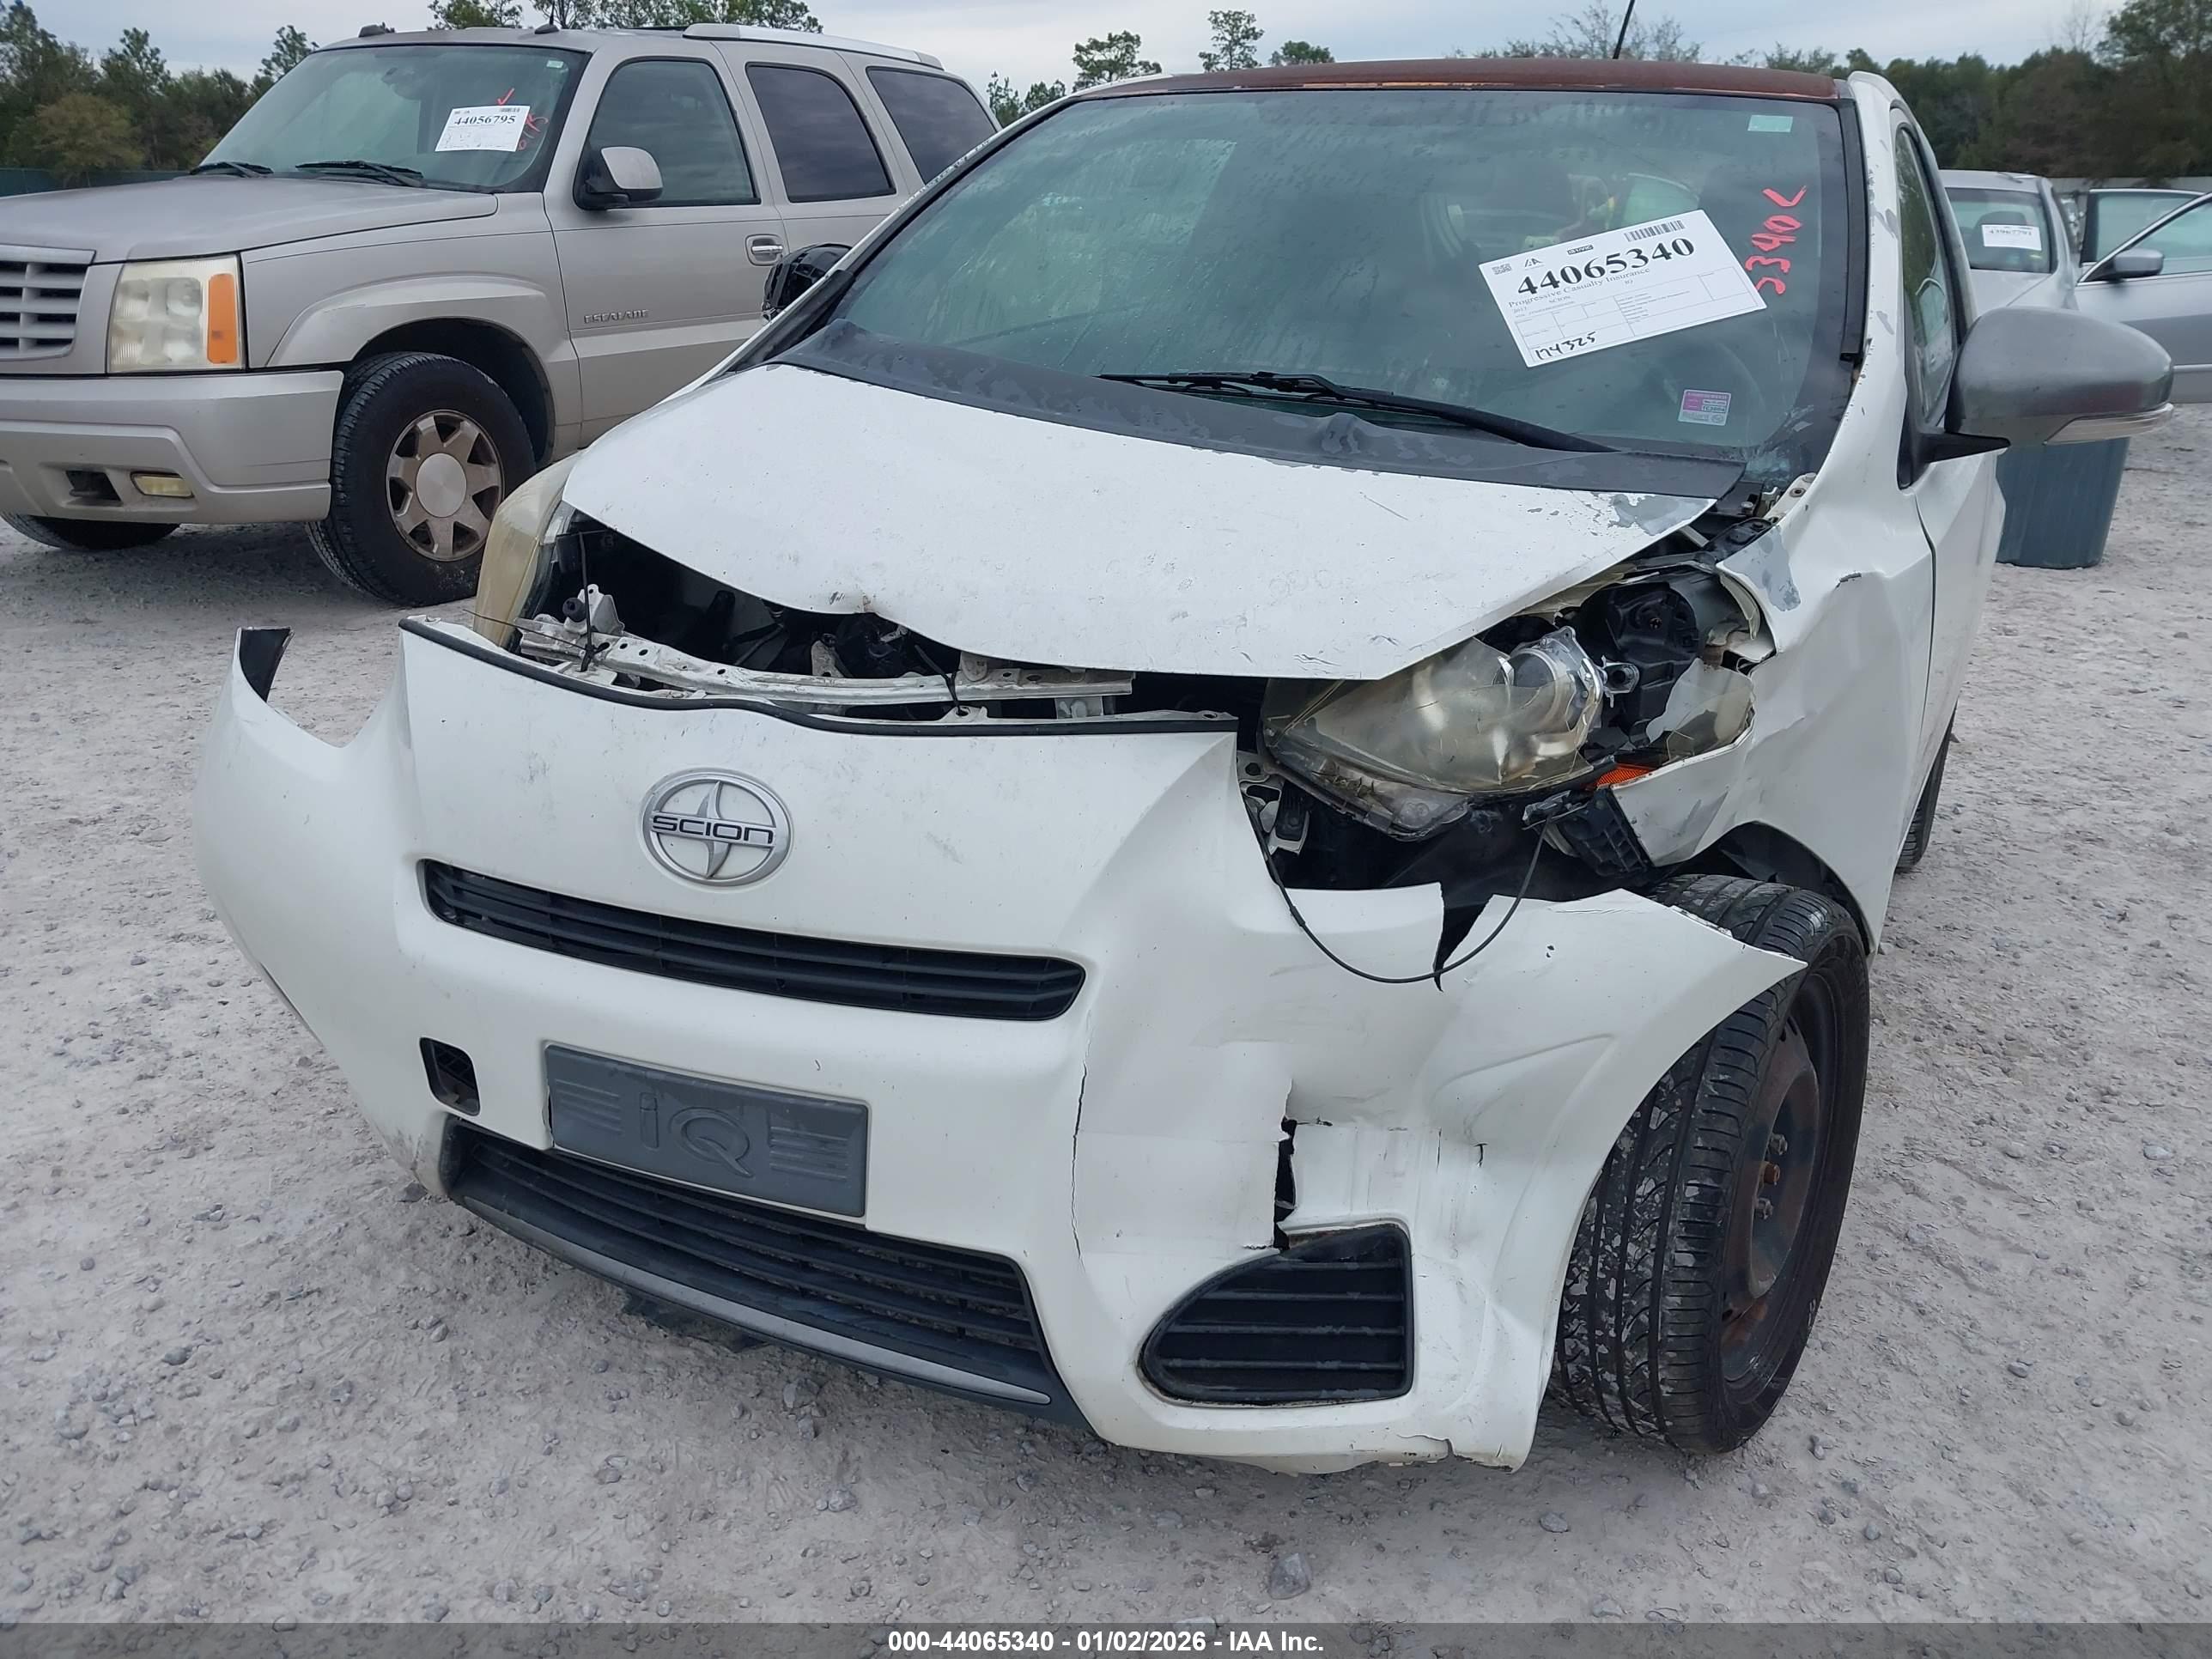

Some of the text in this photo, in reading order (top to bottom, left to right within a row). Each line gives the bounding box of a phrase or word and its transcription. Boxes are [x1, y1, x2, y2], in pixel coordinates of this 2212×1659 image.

[454, 115, 516, 125] 44056795
[1517, 237, 1695, 295] 44065340
[1509, 268, 1650, 307] Progressive Casualty Insurance
[584, 309, 650, 325] ESCALADE
